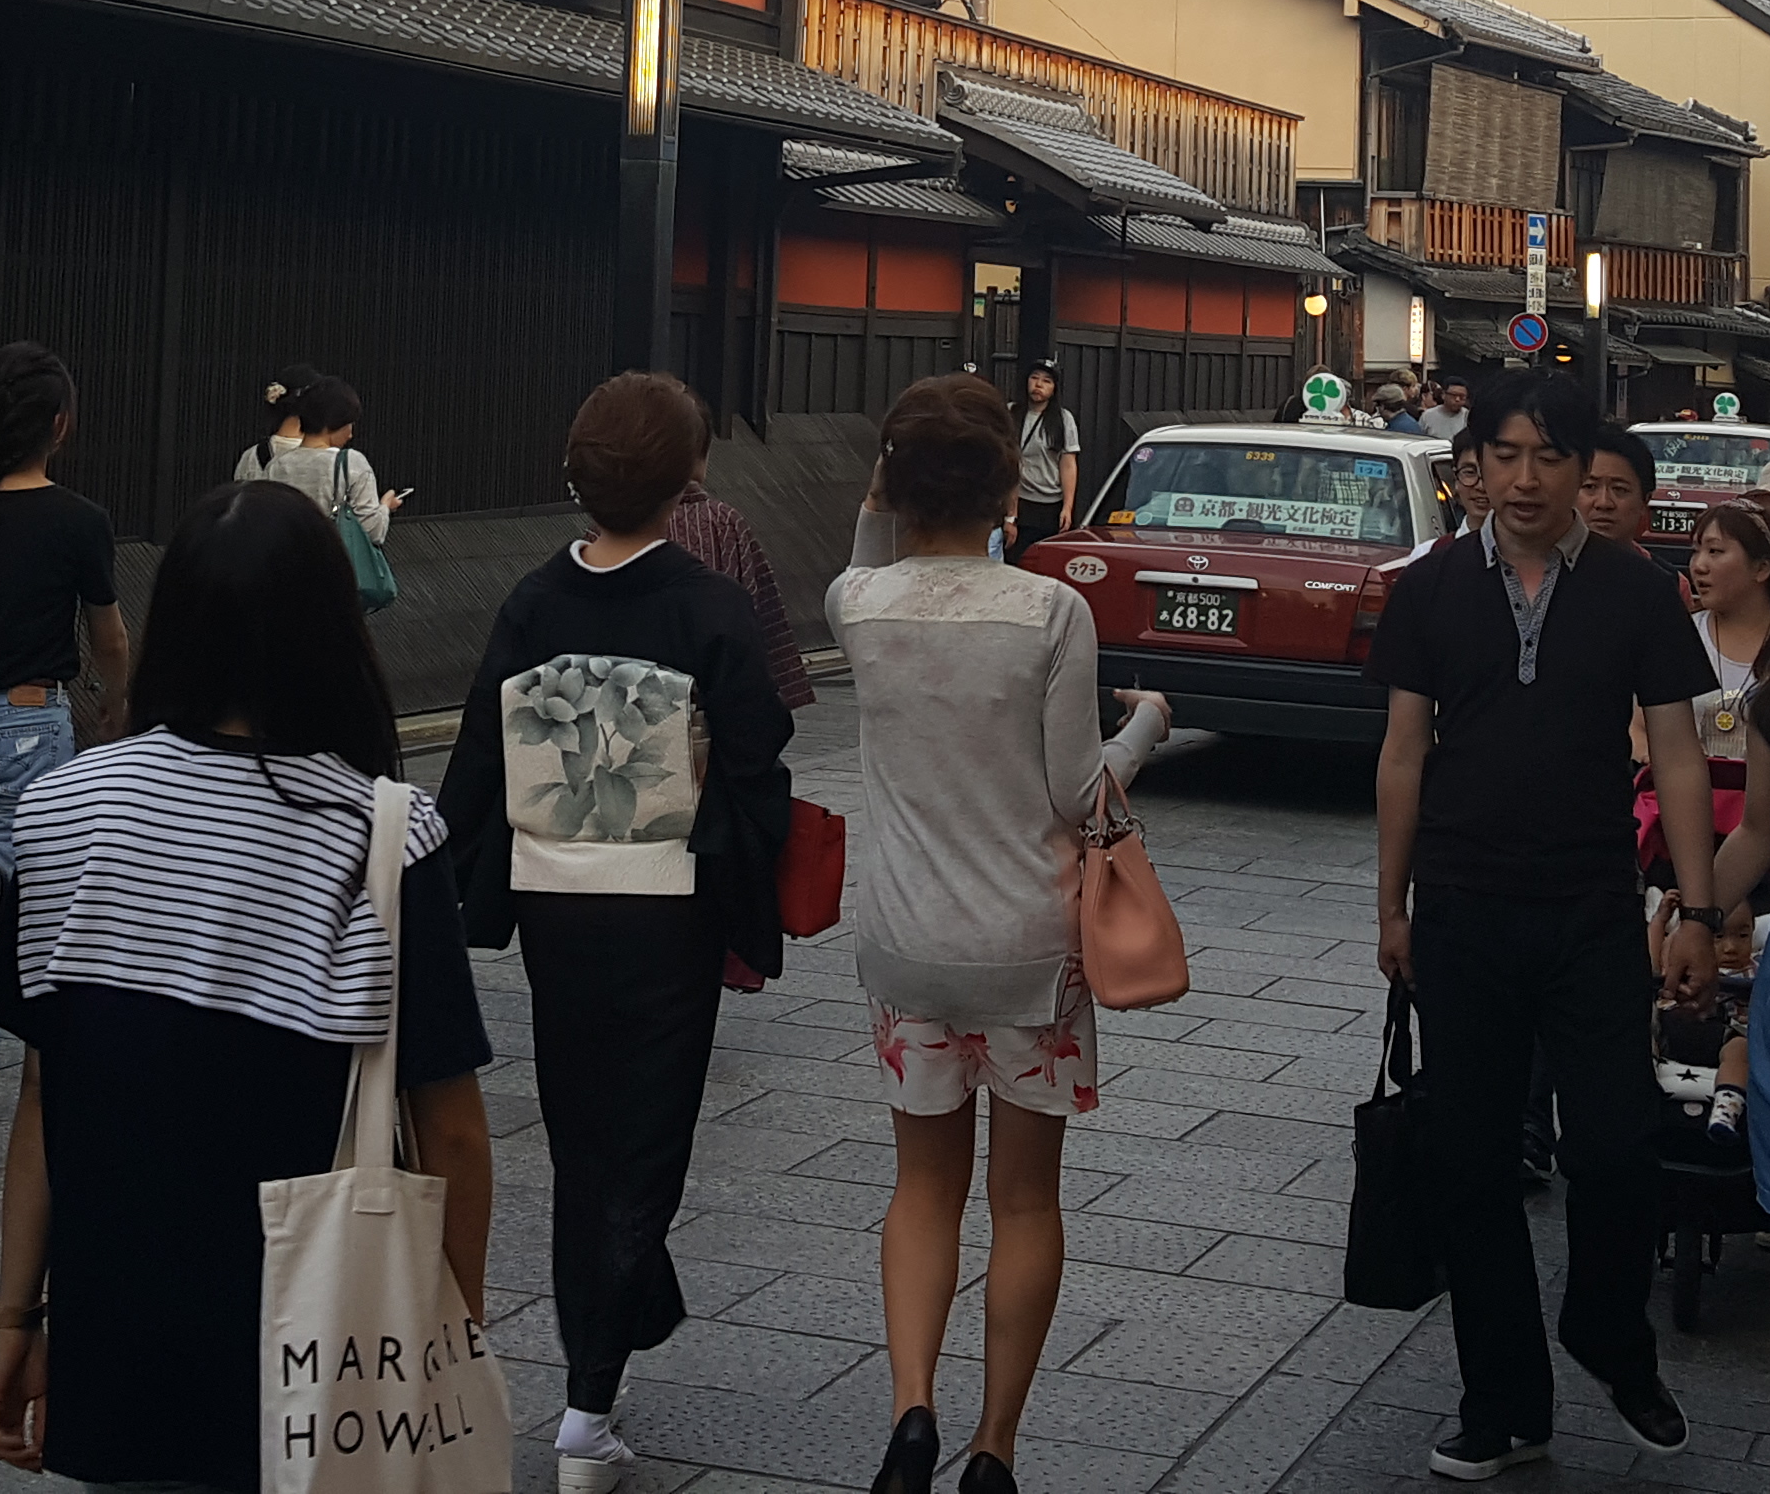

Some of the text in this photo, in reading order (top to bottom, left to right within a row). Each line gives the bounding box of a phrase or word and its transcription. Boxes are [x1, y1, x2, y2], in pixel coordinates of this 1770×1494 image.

[1069, 562, 1106, 576] ラクヨー
[1304, 580, 1358, 592] COMFORT
[1172, 605, 1233, 632] 68-82
